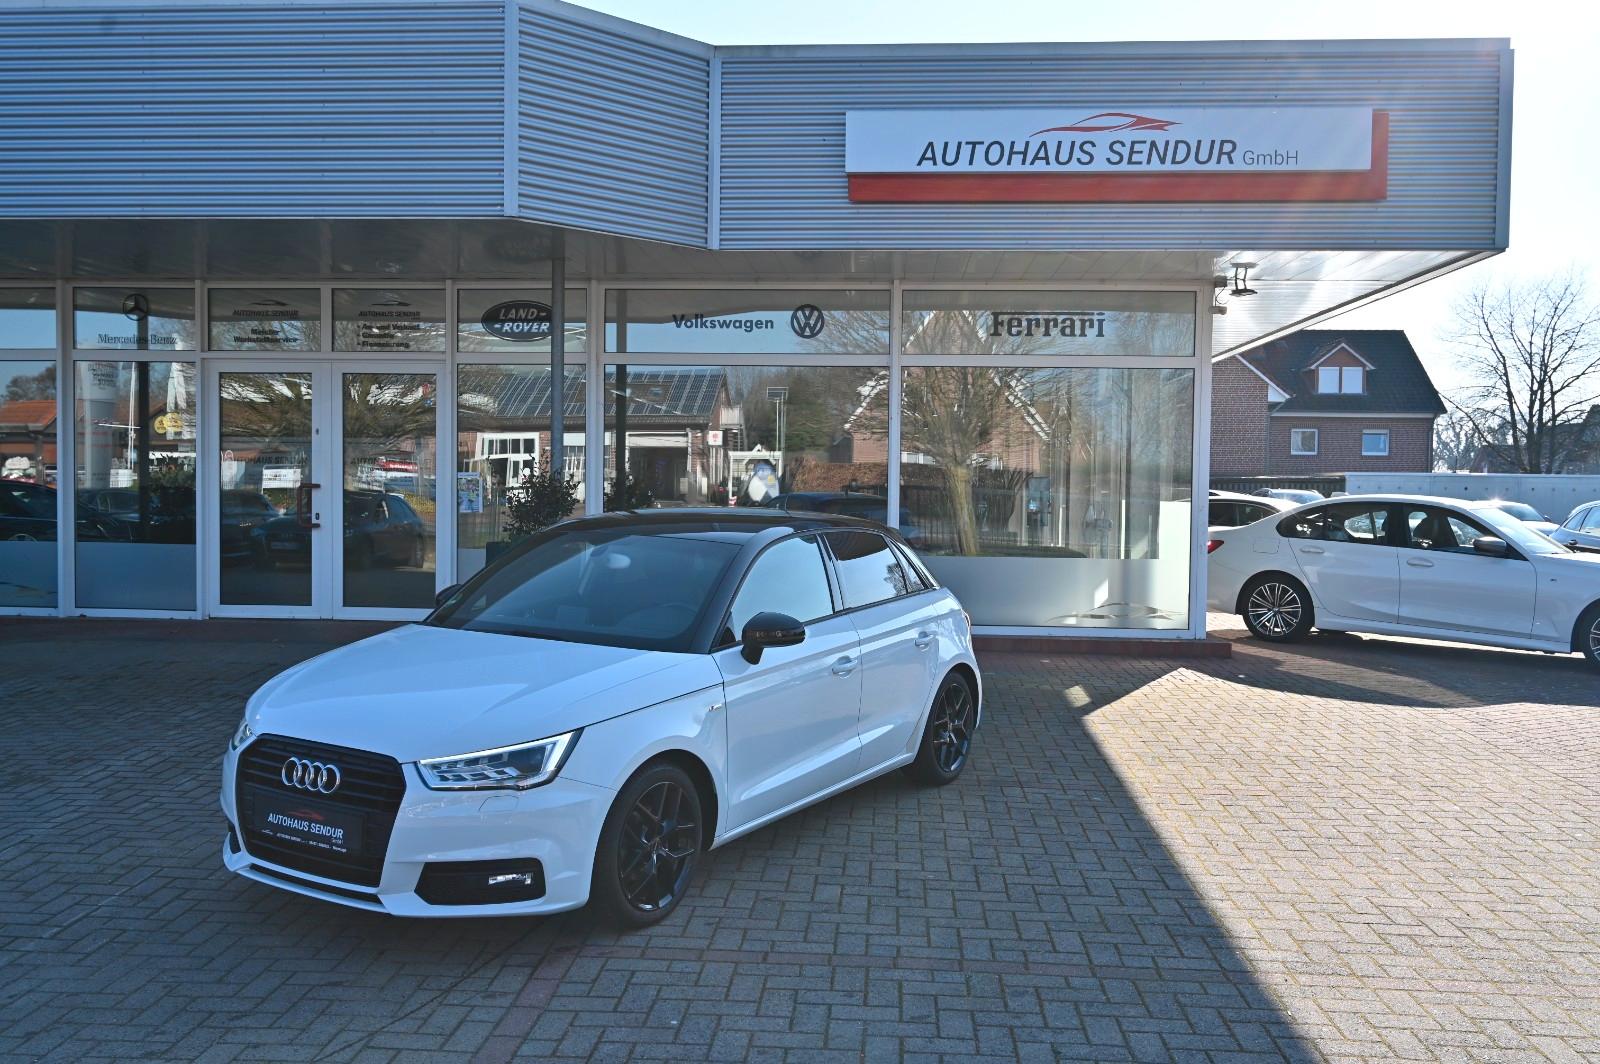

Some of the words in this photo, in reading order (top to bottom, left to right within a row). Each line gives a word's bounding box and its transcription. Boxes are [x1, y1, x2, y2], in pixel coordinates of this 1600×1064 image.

[917, 140, 1096, 167] AUTOHAUS
[1105, 139, 1237, 166] SENDUR
[1242, 150, 1299, 166] GmbH
[672, 314, 774, 333] Volkswagen
[989, 311, 1106, 338] Ferrari
[267, 812, 309, 832] AUTOHAUS
[310, 823, 344, 838] SENDUR
